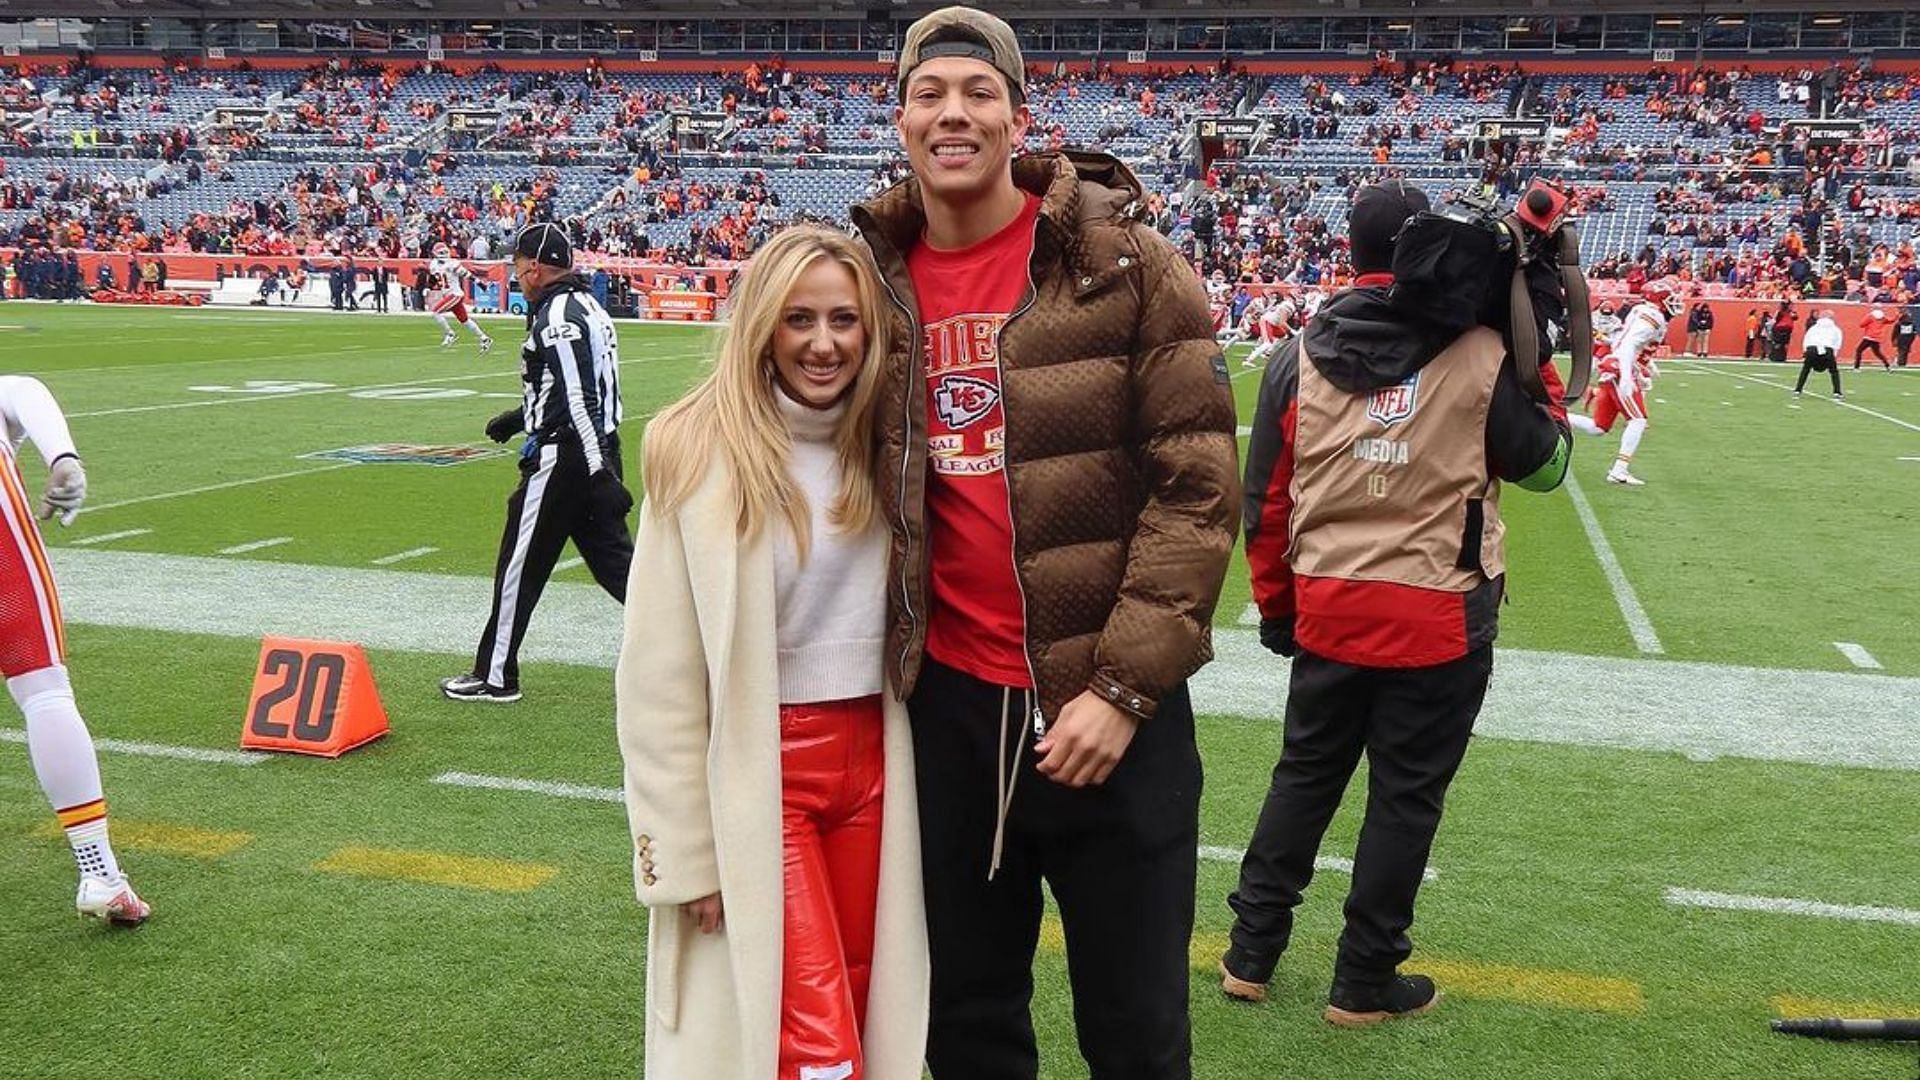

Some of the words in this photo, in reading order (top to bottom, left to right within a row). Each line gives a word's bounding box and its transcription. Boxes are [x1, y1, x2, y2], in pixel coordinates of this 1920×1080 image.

[1217, 124, 1253, 134] BETMGM
[1501, 127, 1540, 136] BETMGM
[547, 323, 575, 341] 42
[950, 386, 987, 413] KC
[1369, 386, 1409, 416] NFL
[1353, 439, 1409, 464] MEDIA
[1367, 474, 1387, 498] 10
[251, 648, 346, 743] 20
